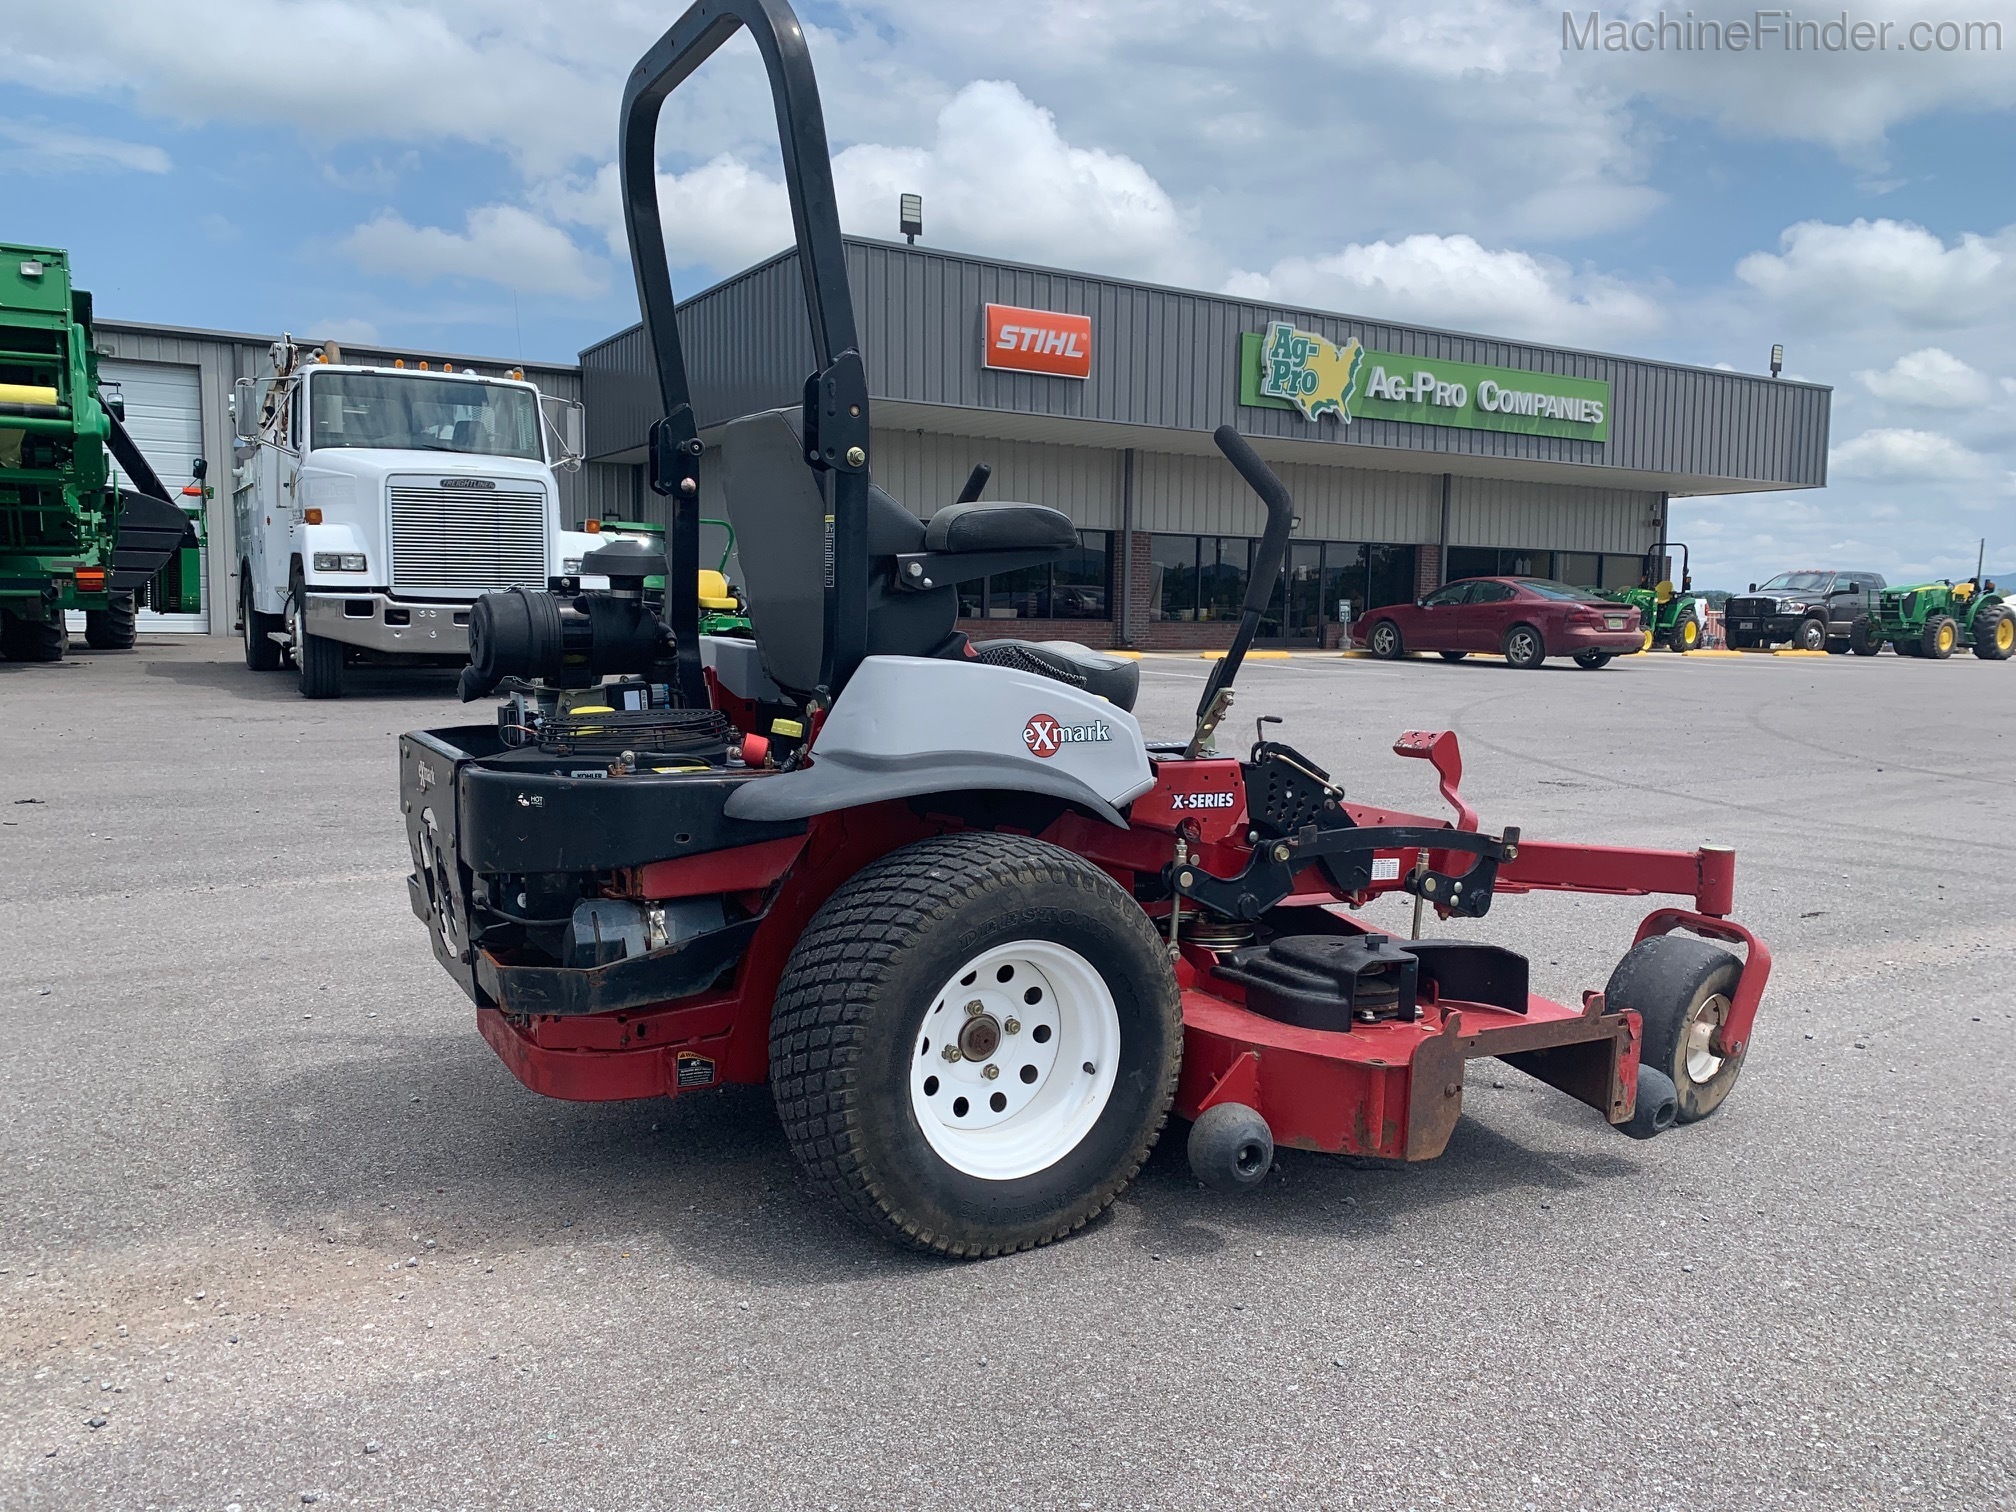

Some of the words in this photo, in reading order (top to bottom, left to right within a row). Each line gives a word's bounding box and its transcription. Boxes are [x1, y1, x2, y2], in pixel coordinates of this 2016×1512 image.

[995, 324, 1084, 358] STIHL
[1269, 326, 1320, 368] Ag-
[1267, 358, 1319, 396] Pro
[1022, 720, 1112, 751] eXmark
[1171, 792, 1235, 809] X-SERIES
[957, 905, 1116, 952] DEESTONE
